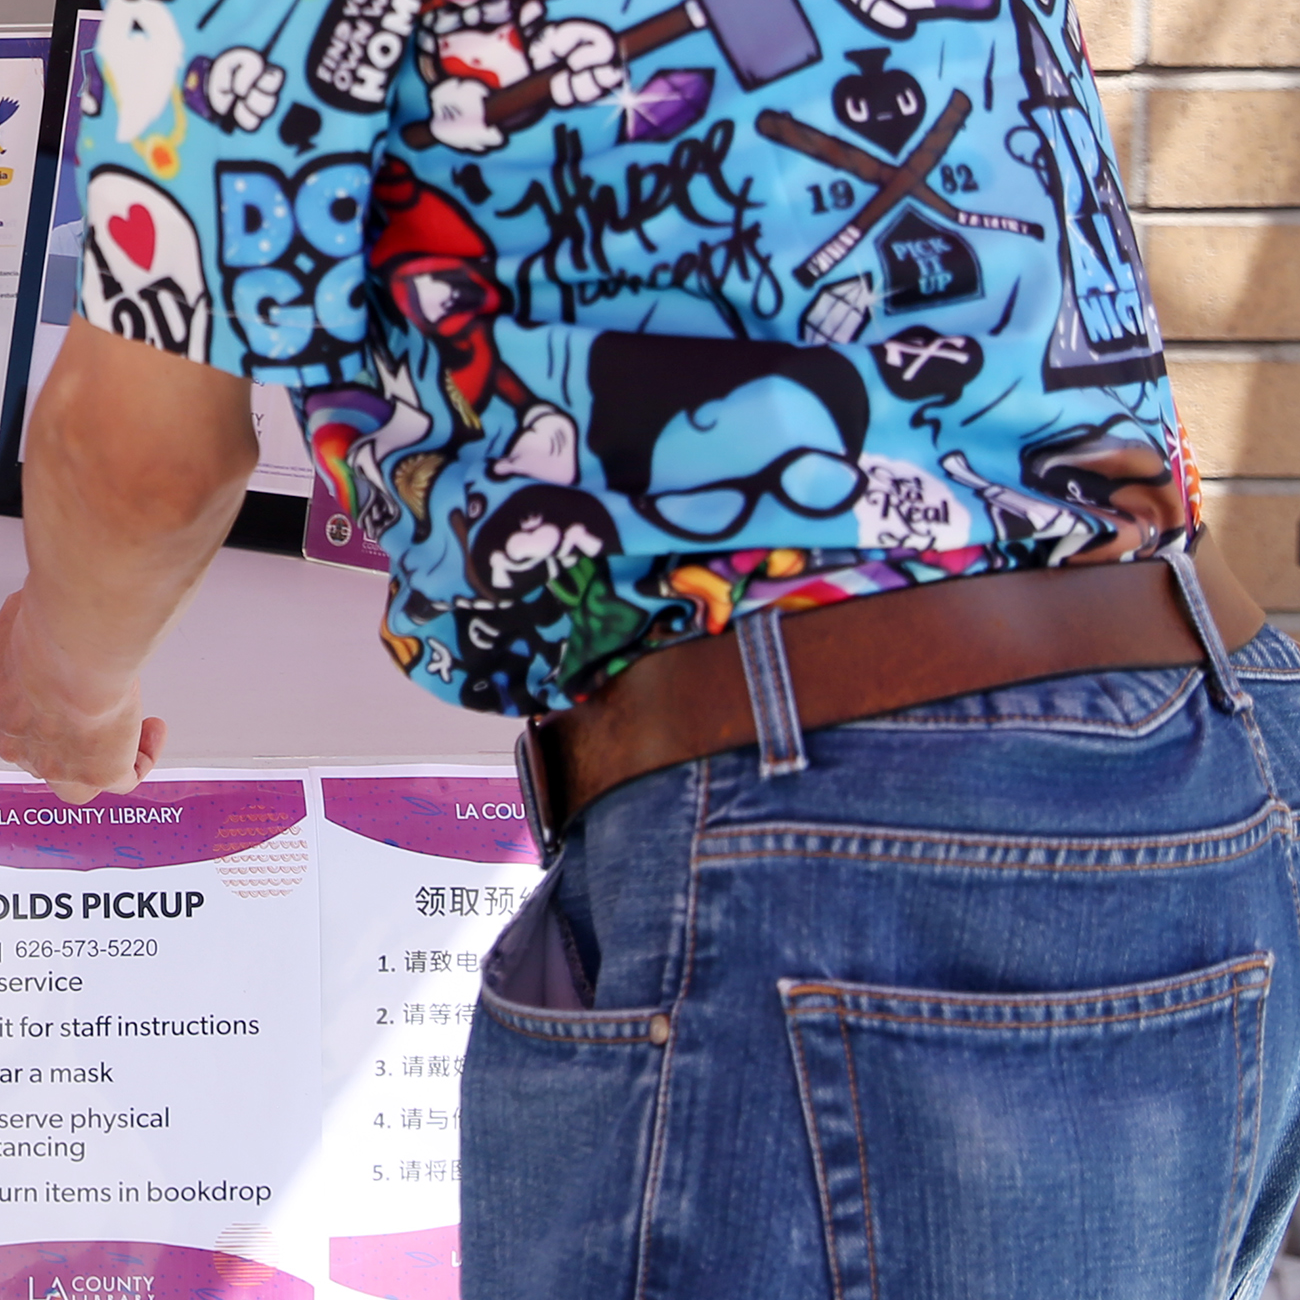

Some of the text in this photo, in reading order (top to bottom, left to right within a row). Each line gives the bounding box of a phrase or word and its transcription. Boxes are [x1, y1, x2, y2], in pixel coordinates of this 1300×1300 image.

[808, 165, 978, 214] 19 82
[82, 891, 205, 919] PICKUP
[15, 938, 158, 958] 626-573-5220
[377, 955, 395, 973] 1.
[19, 1016, 54, 1038] for
[60, 1015, 113, 1038] staff
[117, 1014, 260, 1037] instructions
[376, 1008, 394, 1024] 2.
[29, 1067, 42, 1084] a
[50, 1061, 114, 1083] mask
[71, 1106, 170, 1134] physical
[45, 1181, 112, 1203] items
[119, 1181, 139, 1202] in
[147, 1179, 272, 1206] bookdrop
